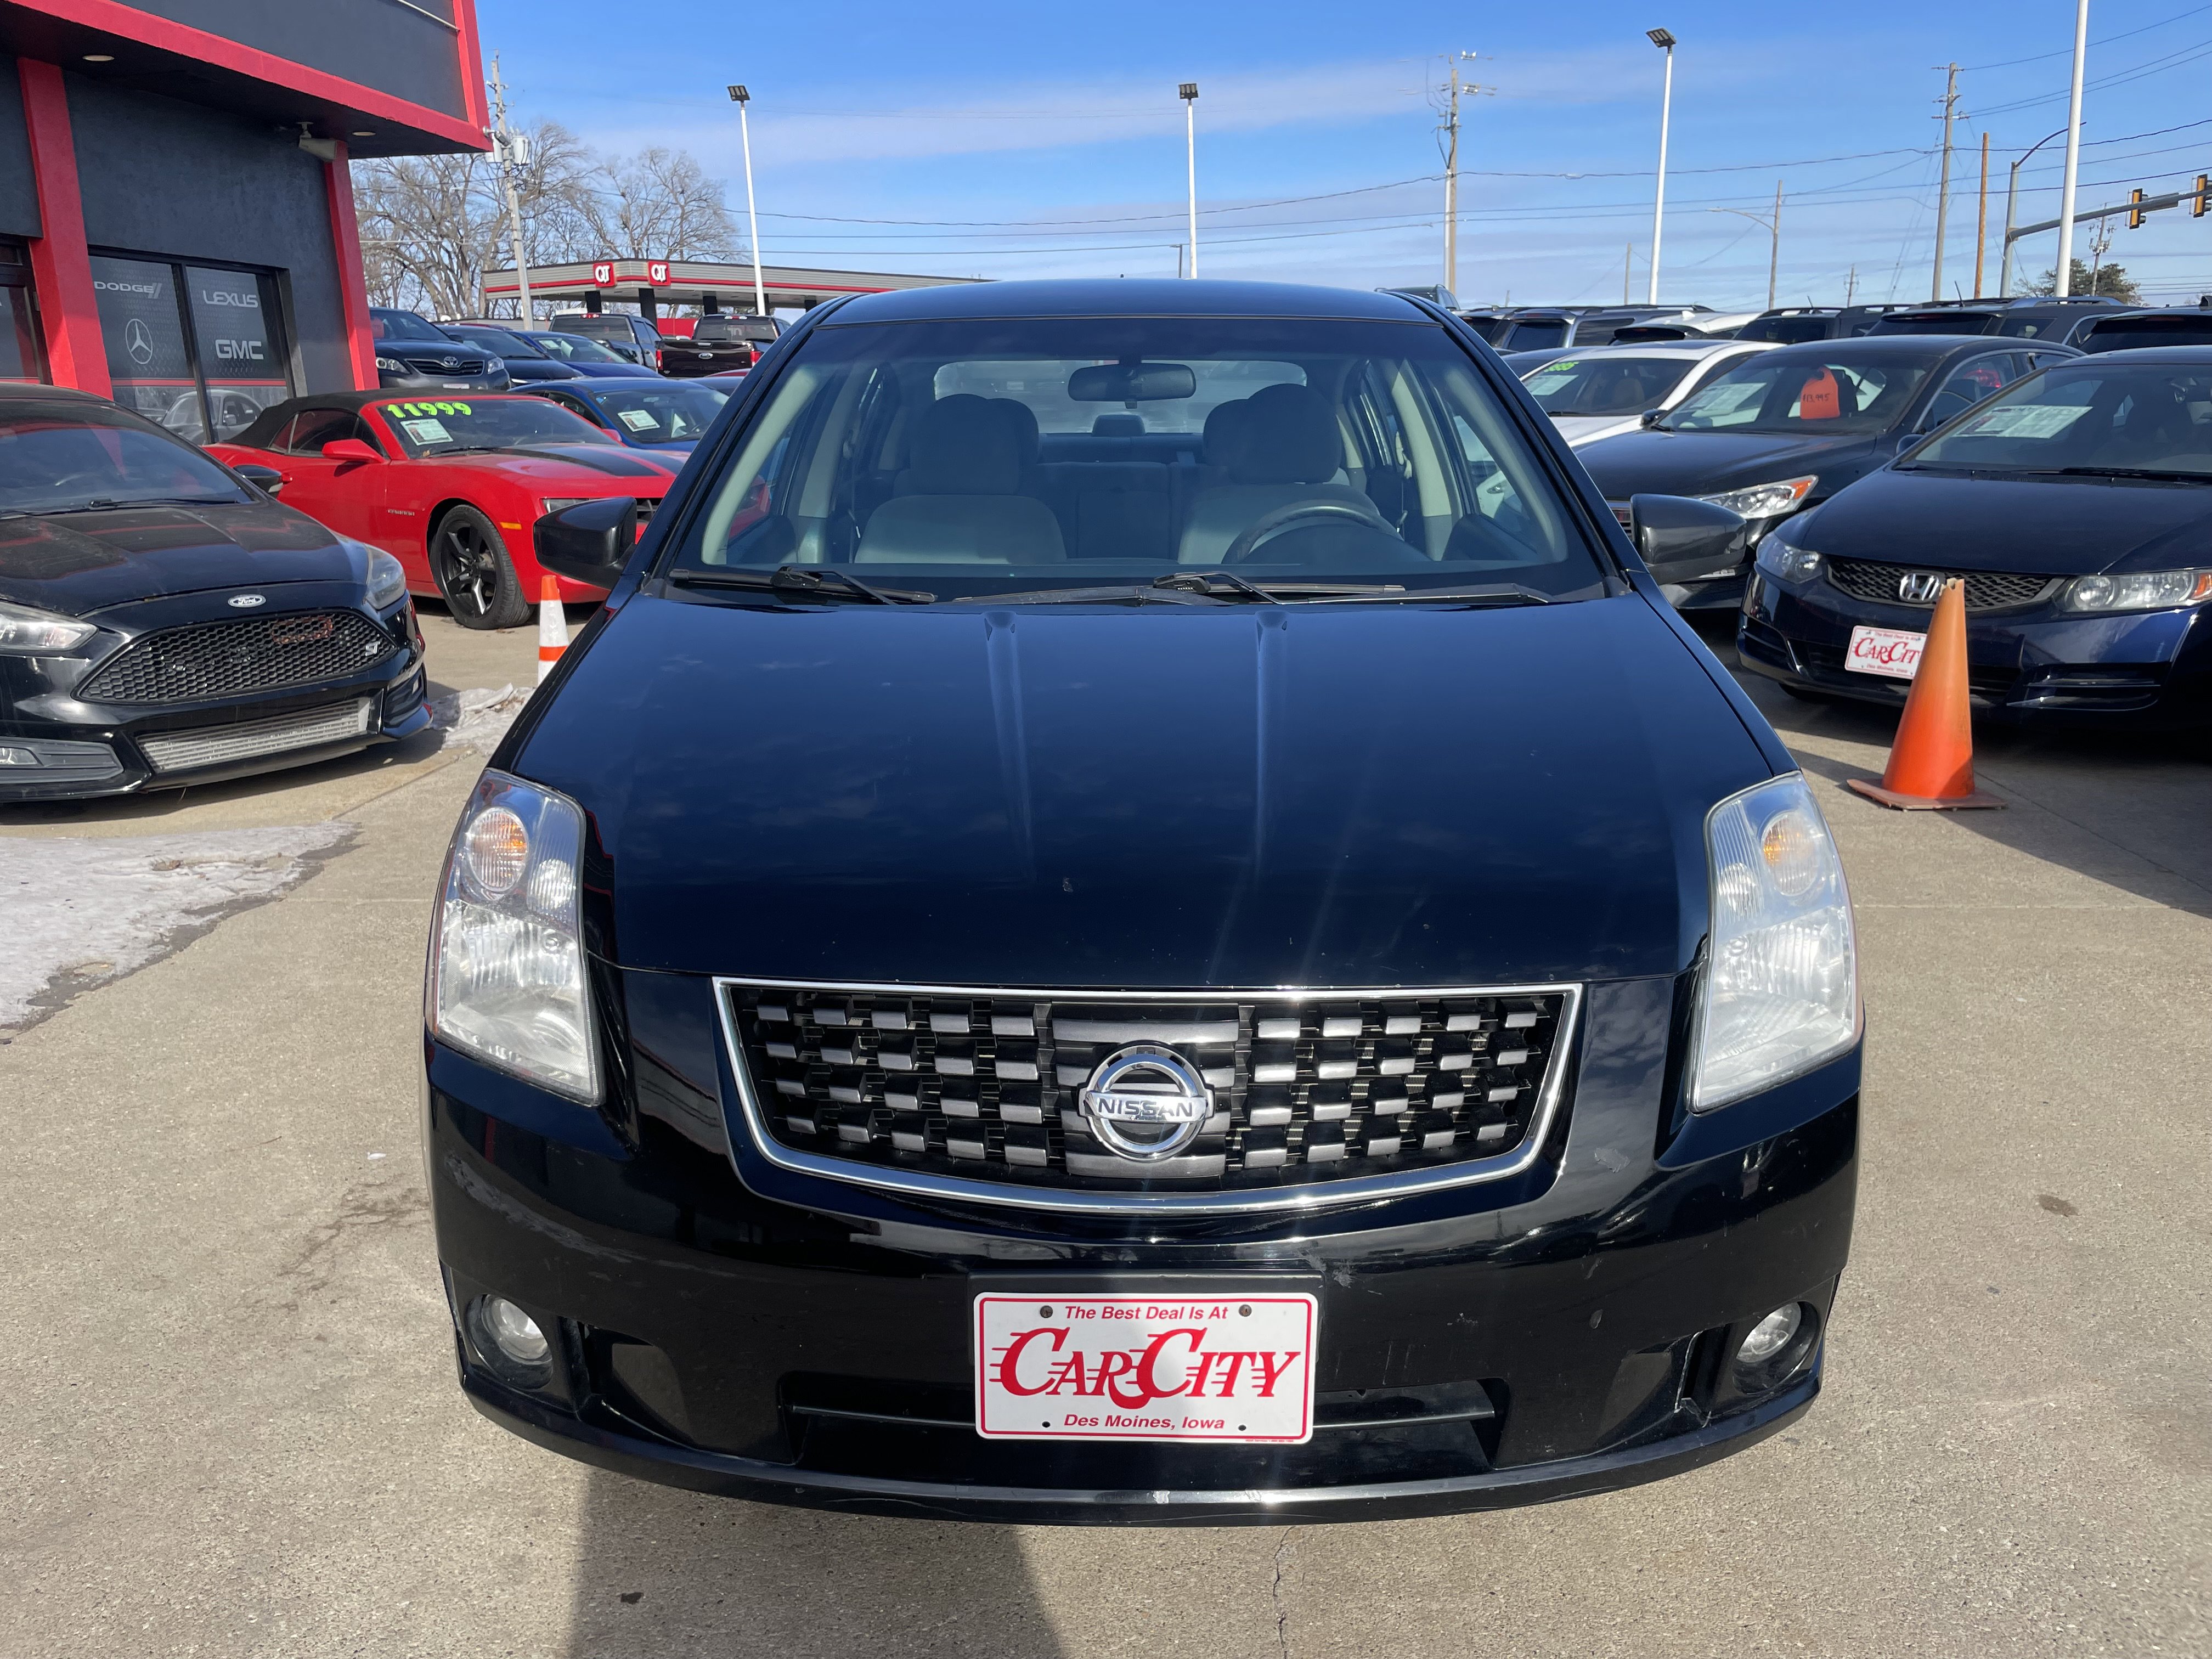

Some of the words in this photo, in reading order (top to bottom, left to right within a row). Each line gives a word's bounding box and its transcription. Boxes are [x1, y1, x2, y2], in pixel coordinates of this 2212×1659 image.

[595, 265, 610, 283] QT
[651, 264, 667, 282] QT
[94, 281, 154, 294] DODGE
[202, 290, 259, 308] LEXUS
[215, 339, 264, 360] GMC
[387, 402, 472, 419] 11999
[1098, 1098, 1193, 1117] NISSAN
[1065, 1306, 1096, 1319] The
[1101, 1306, 1141, 1319] Best
[1146, 1306, 1184, 1319] Deal
[1189, 1306, 1204, 1319] Is
[1207, 1306, 1228, 1319] At
[1064, 1414, 1099, 1426] Des
[1105, 1415, 1176, 1430] Moines,
[1182, 1417, 1224, 1429] Iowa
